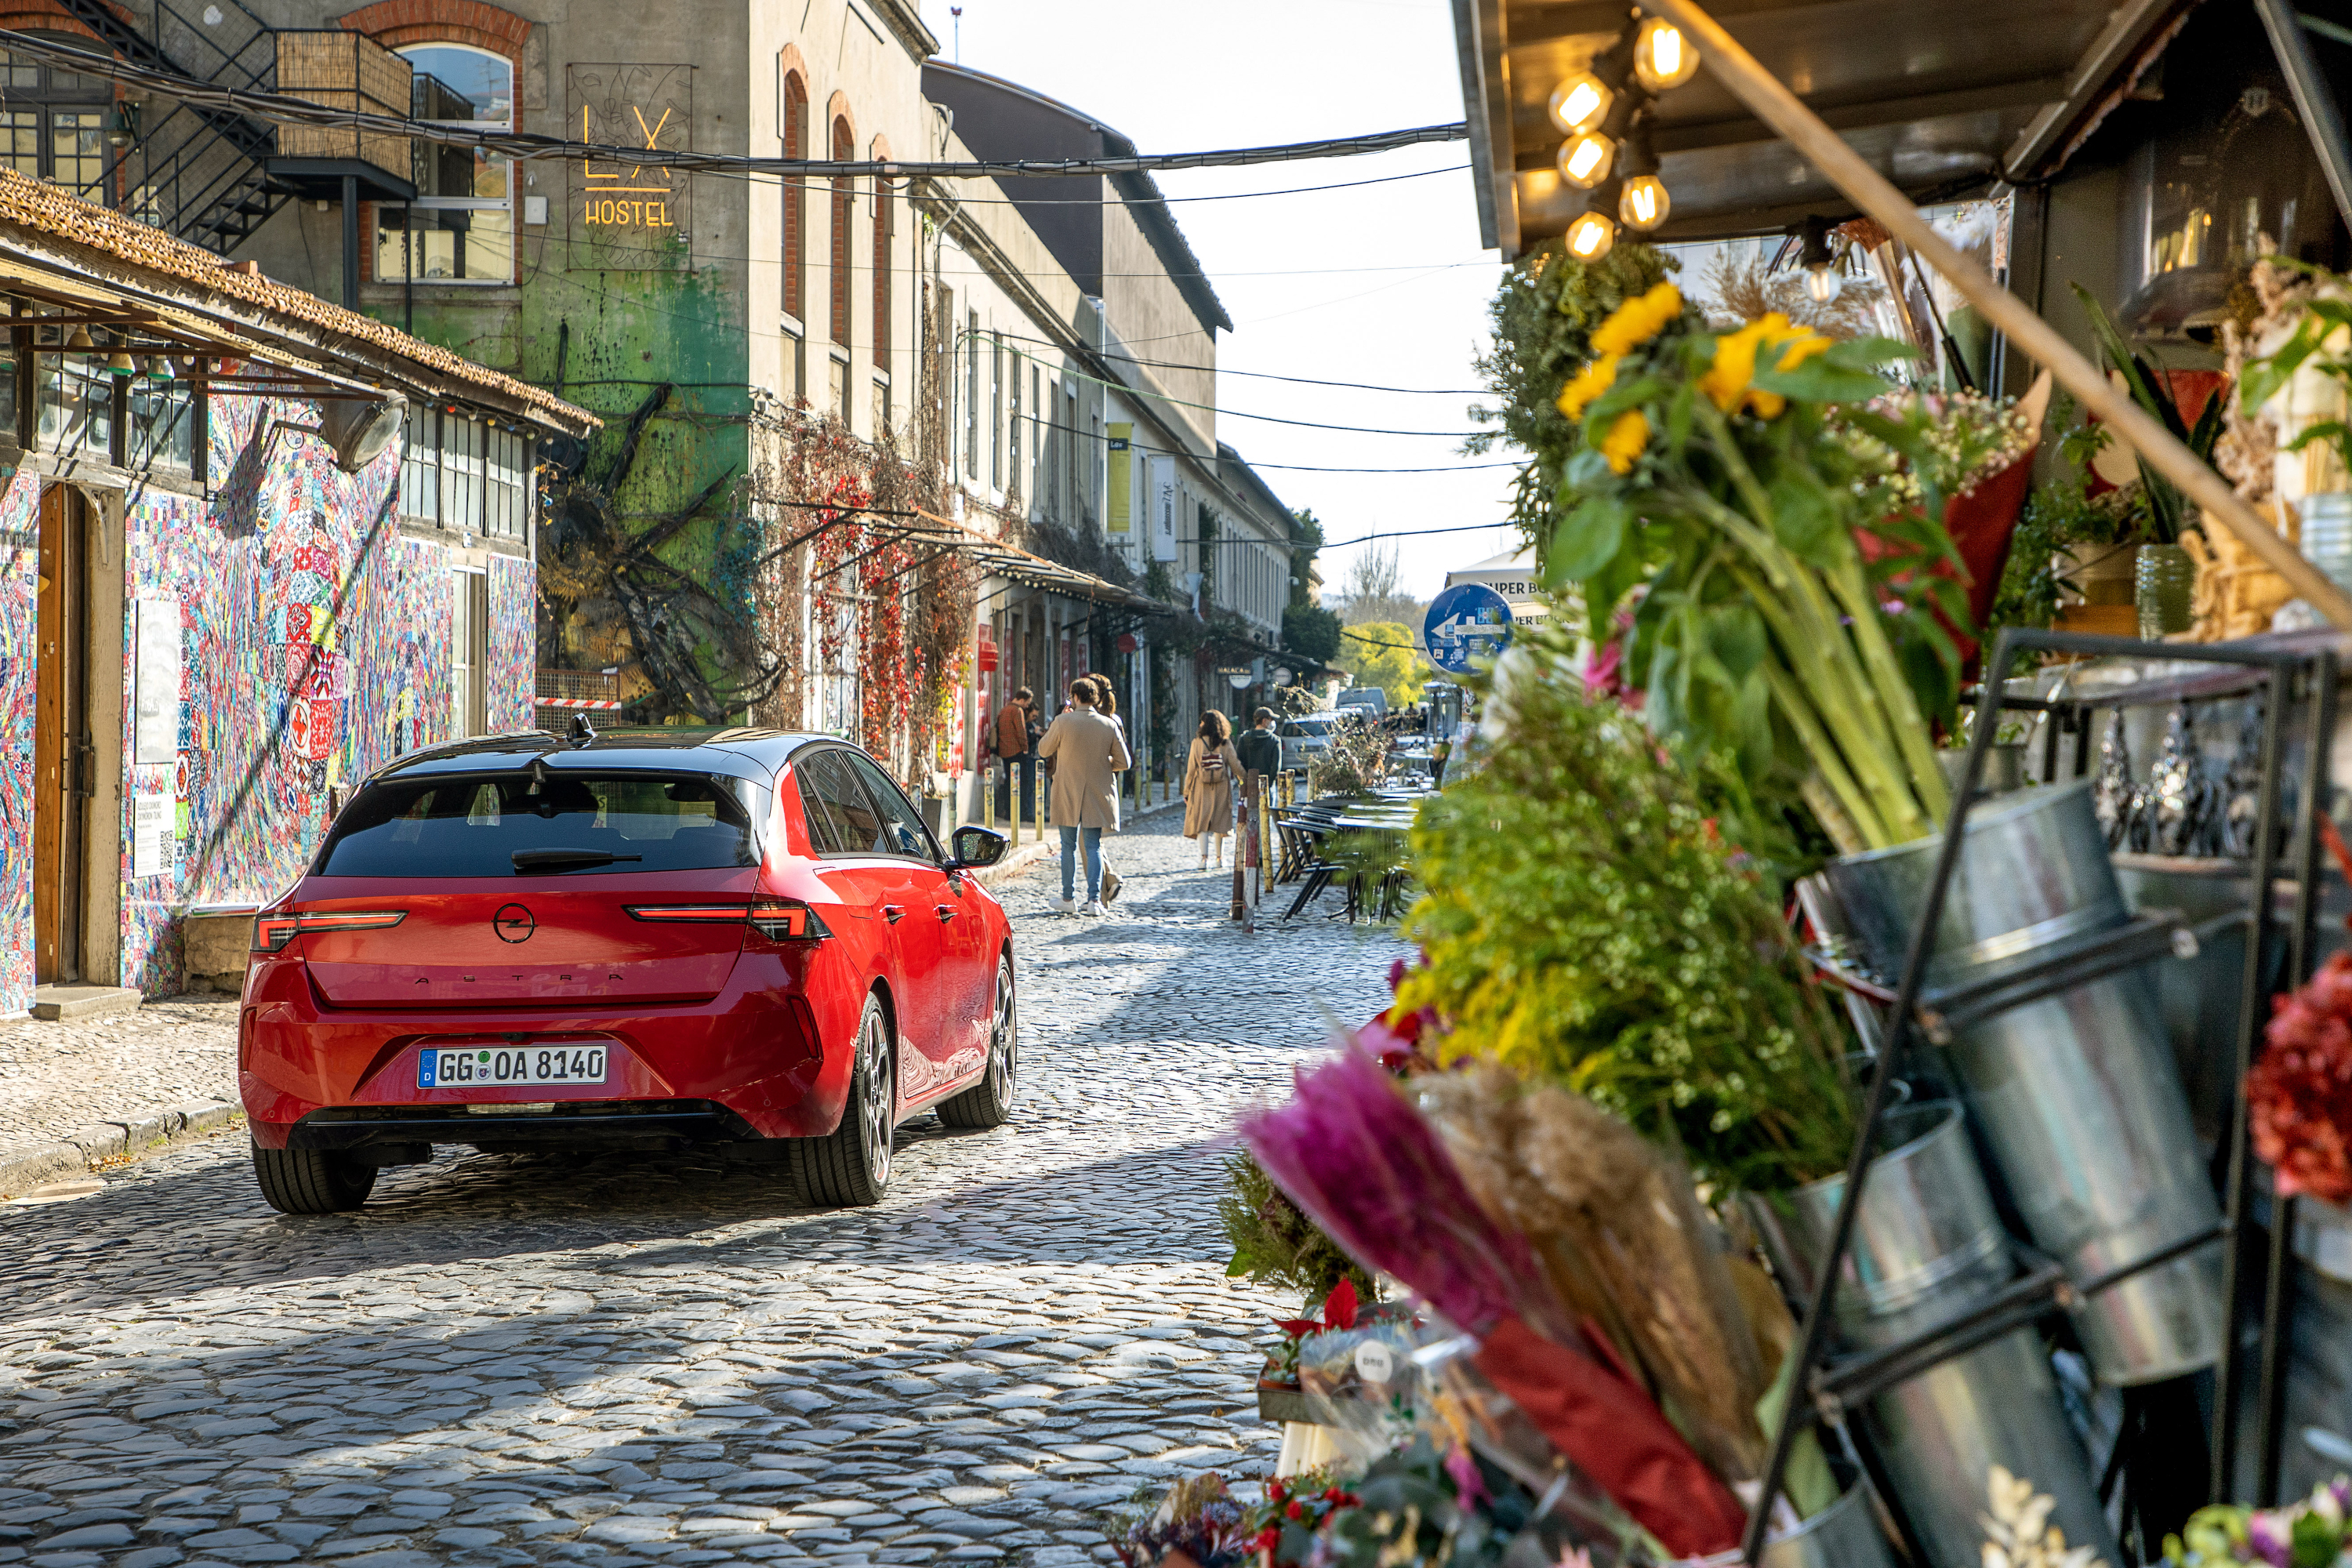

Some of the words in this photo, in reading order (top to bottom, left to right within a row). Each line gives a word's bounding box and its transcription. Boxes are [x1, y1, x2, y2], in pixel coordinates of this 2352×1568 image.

[584, 104, 671, 179] LX
[586, 200, 673, 227] HOSTEL
[1483, 582, 1526, 594] UPER
[416, 975, 623, 985] ASTRA
[439, 1053, 473, 1082] GG
[495, 1051, 527, 1080] OA
[536, 1050, 604, 1079] 8140
[424, 1073, 431, 1081] D
